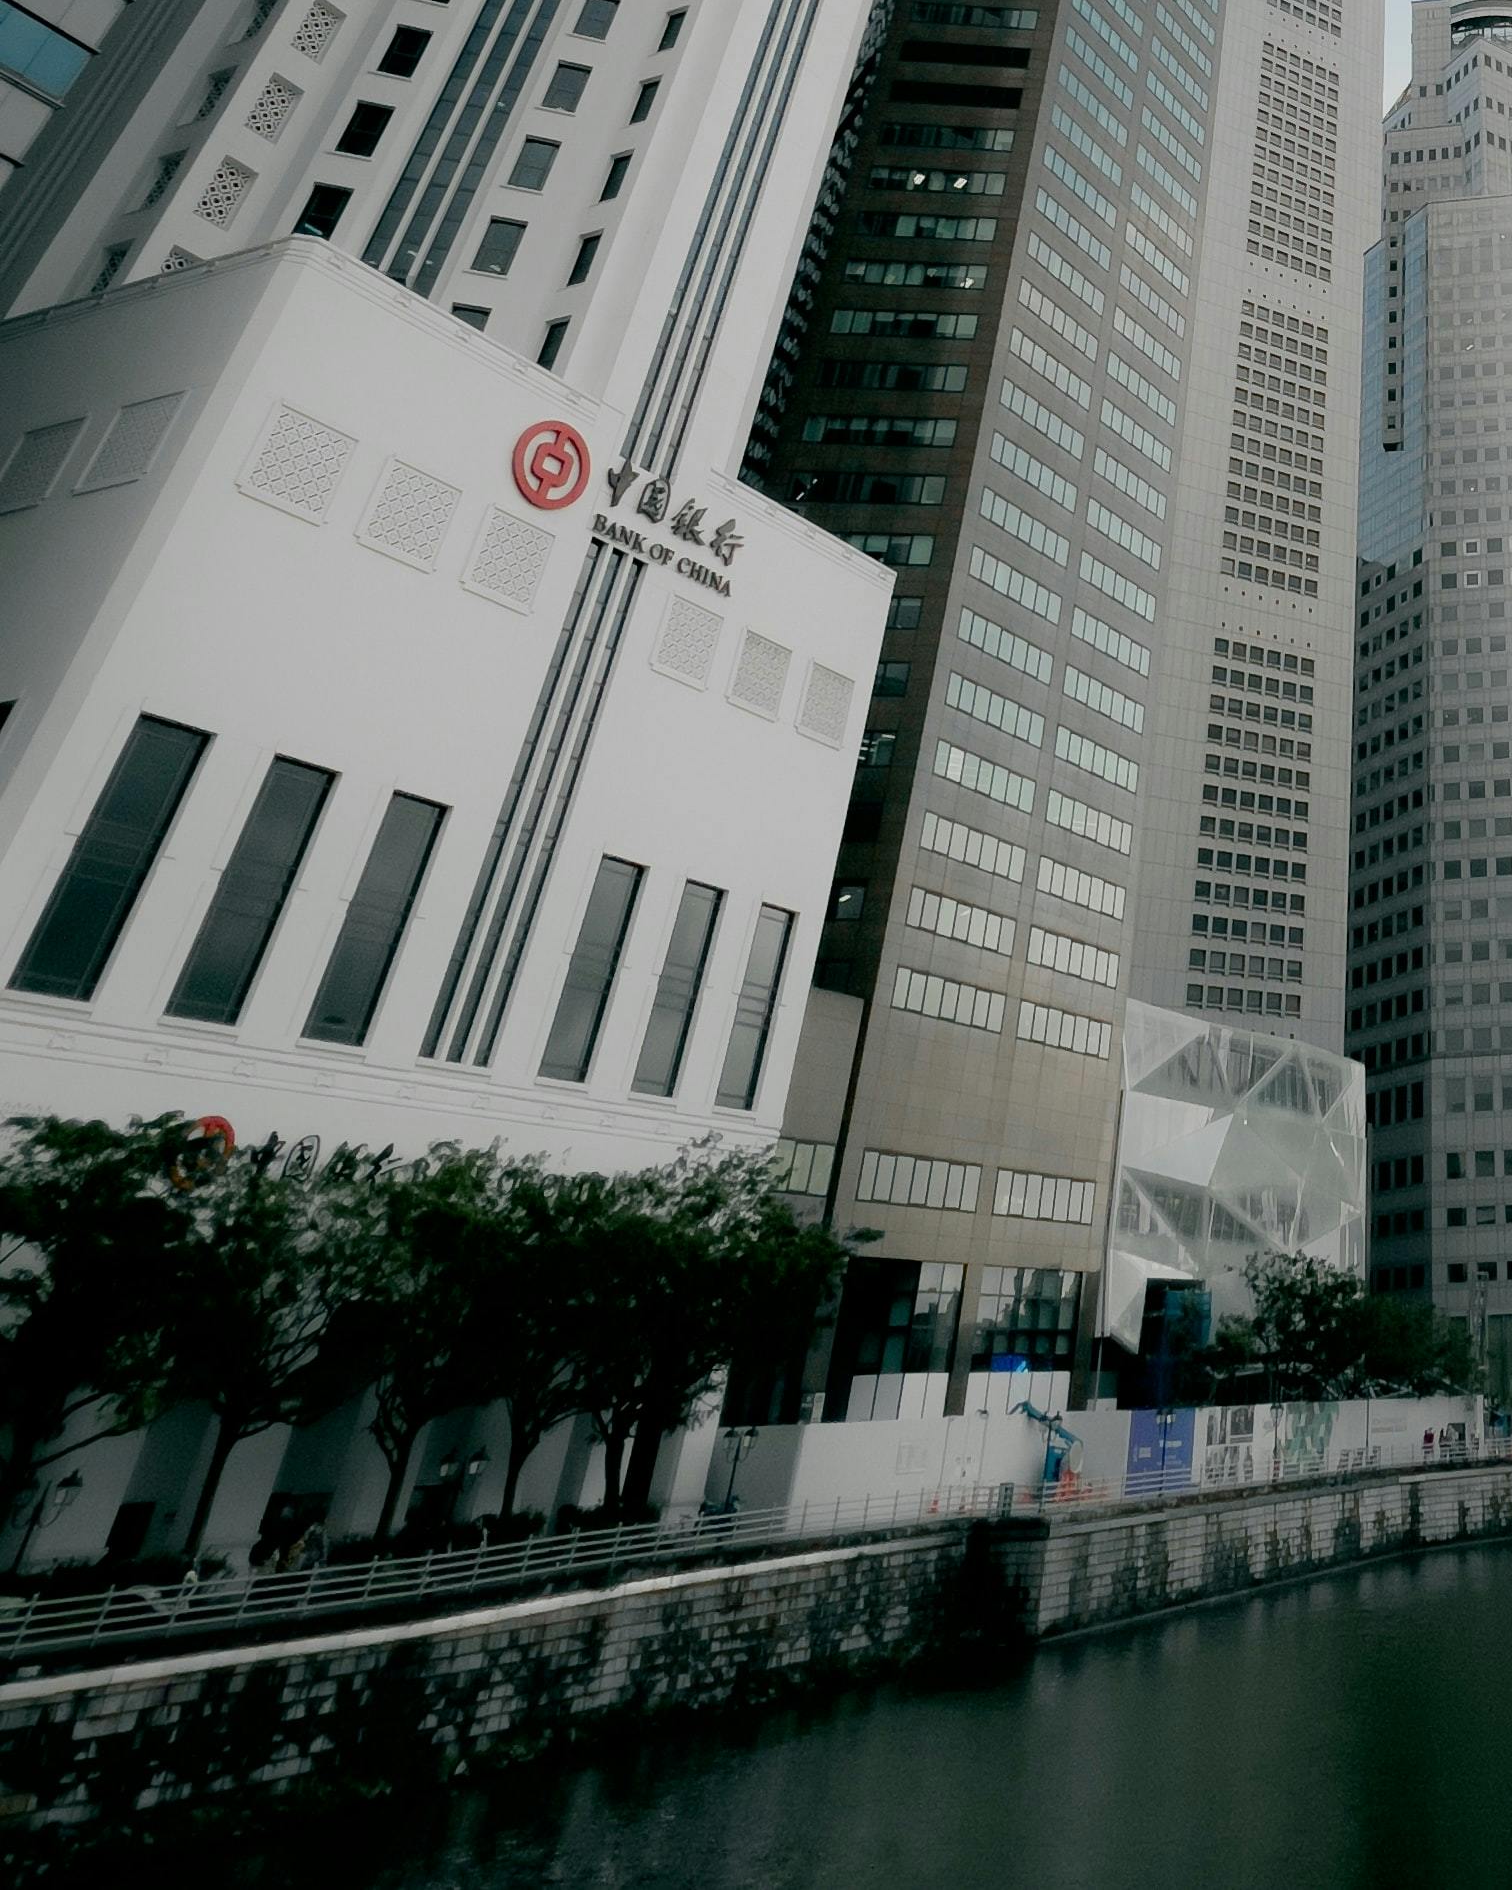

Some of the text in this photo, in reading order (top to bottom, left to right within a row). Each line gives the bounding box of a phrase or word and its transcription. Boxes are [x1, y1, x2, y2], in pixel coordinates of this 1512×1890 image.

[592, 513, 731, 597] BANK OF CHINA
